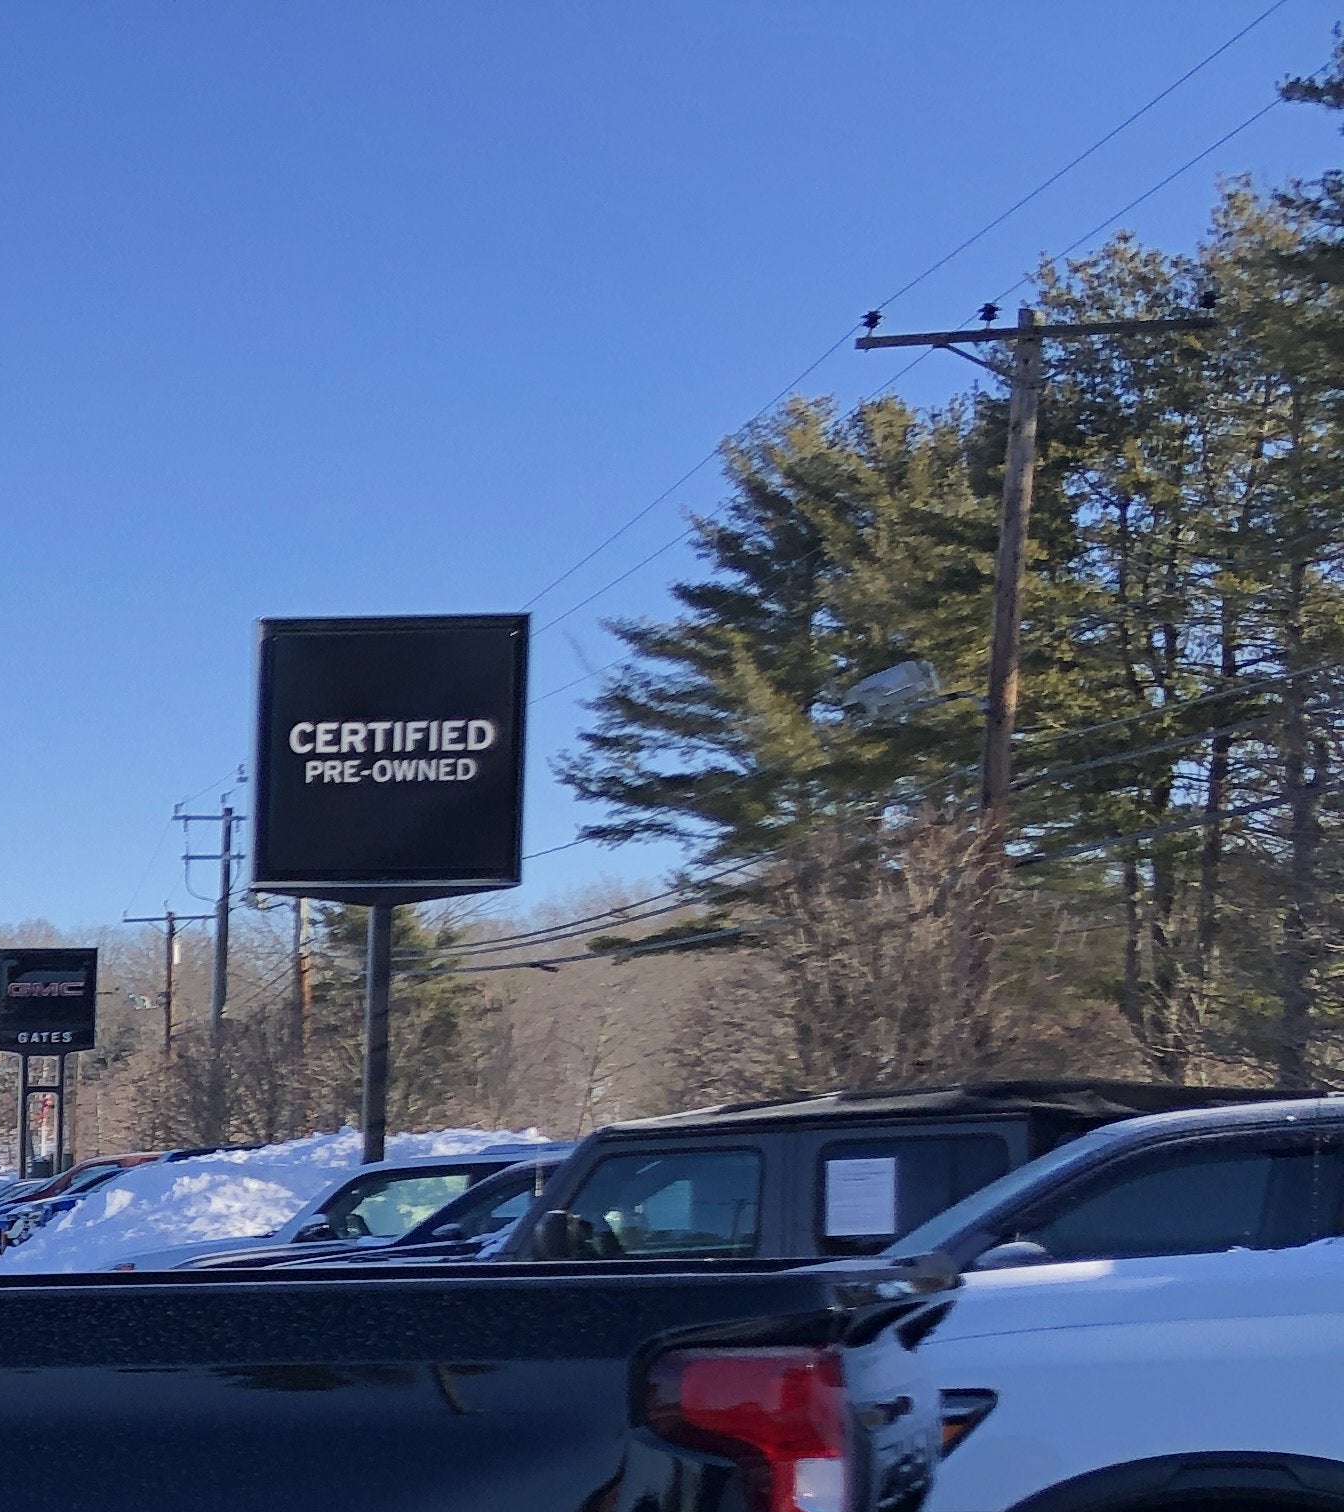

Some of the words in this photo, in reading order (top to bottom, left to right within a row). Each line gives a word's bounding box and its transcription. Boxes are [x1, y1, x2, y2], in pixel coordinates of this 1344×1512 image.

[289, 719, 496, 754] CERTIFIED
[305, 758, 478, 783] PRE-OWNED
[7, 981, 85, 997] GMC
[17, 1031, 73, 1043] GATES
